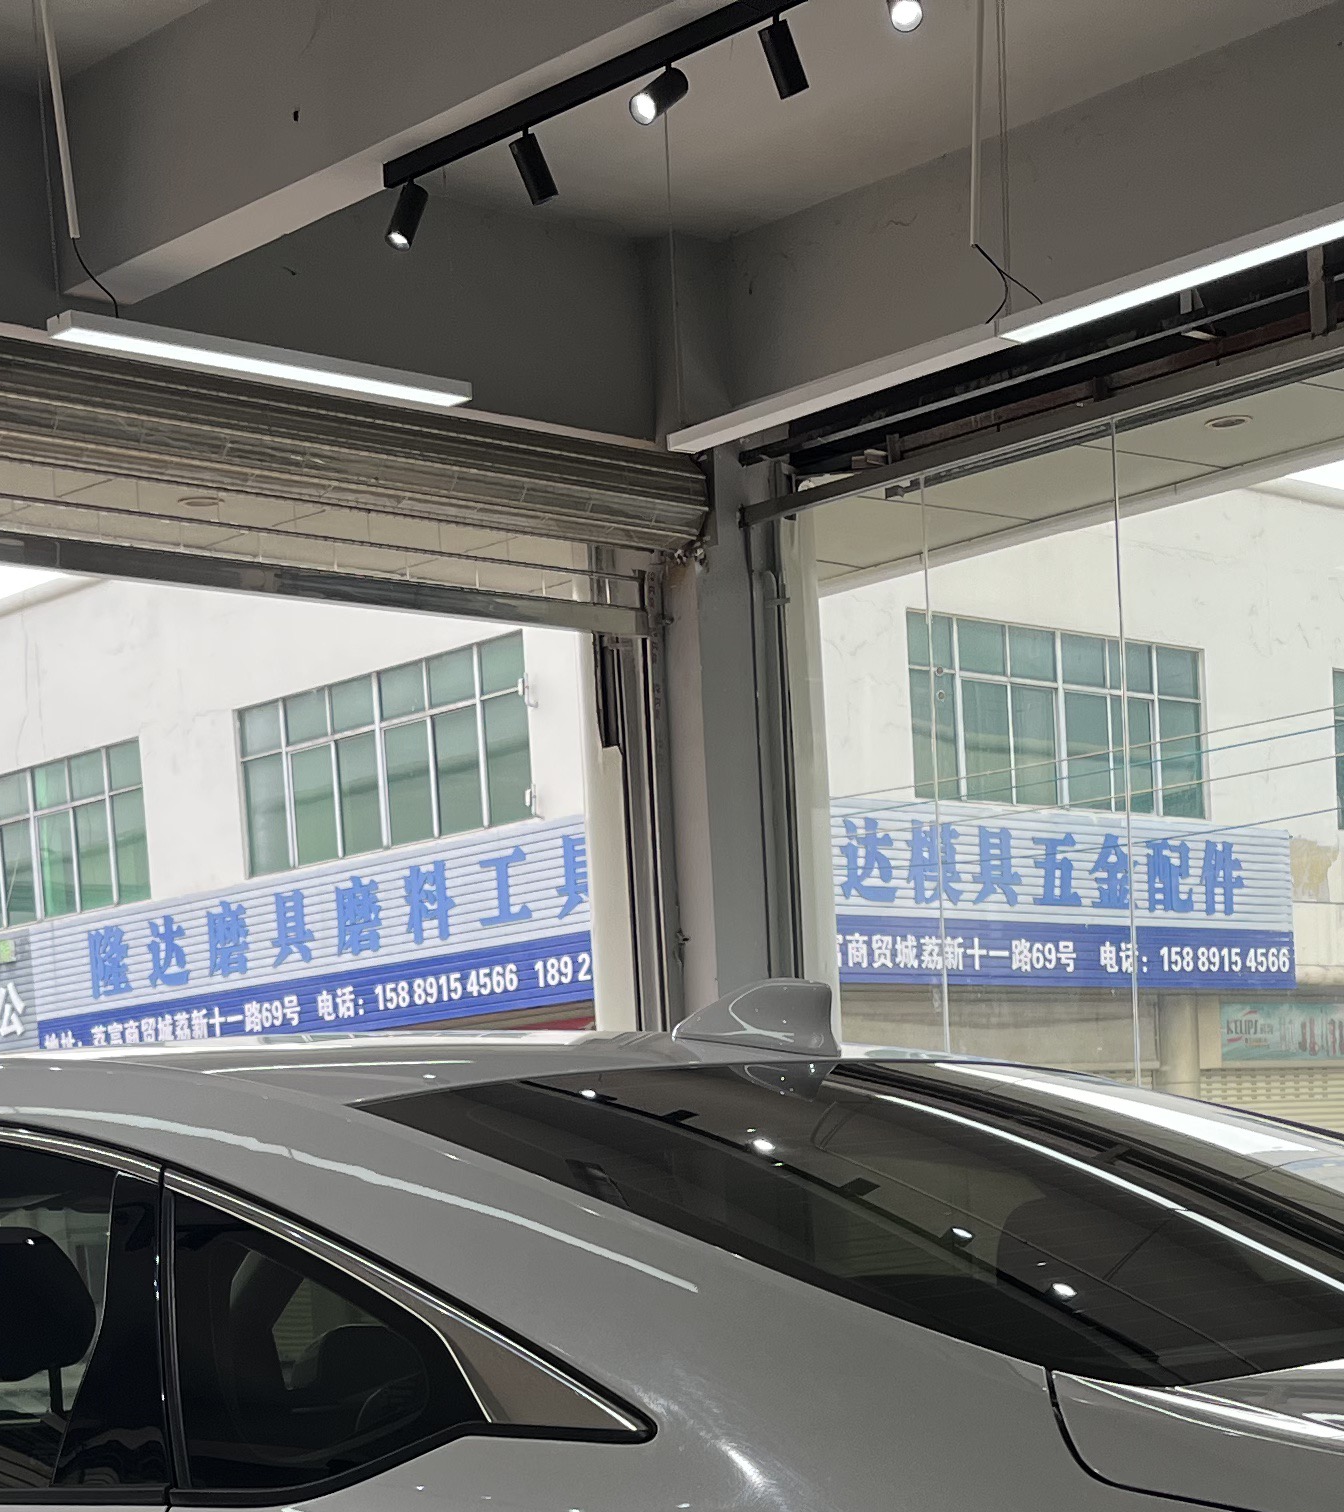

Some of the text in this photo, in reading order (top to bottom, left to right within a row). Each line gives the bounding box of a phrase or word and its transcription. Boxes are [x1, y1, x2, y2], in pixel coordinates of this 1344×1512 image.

[839, 816, 1245, 916] 达模具五金配件
[87, 834, 590, 1000] 隆达磨具磨料工具
[373, 981, 410, 1012] 158
[413, 972, 463, 1006] 8915
[466, 962, 518, 997] 4566
[534, 955, 574, 988] 189
[1160, 946, 1194, 973] 158
[1197, 947, 1243, 973] 8915
[1246, 947, 1291, 973] 4566
